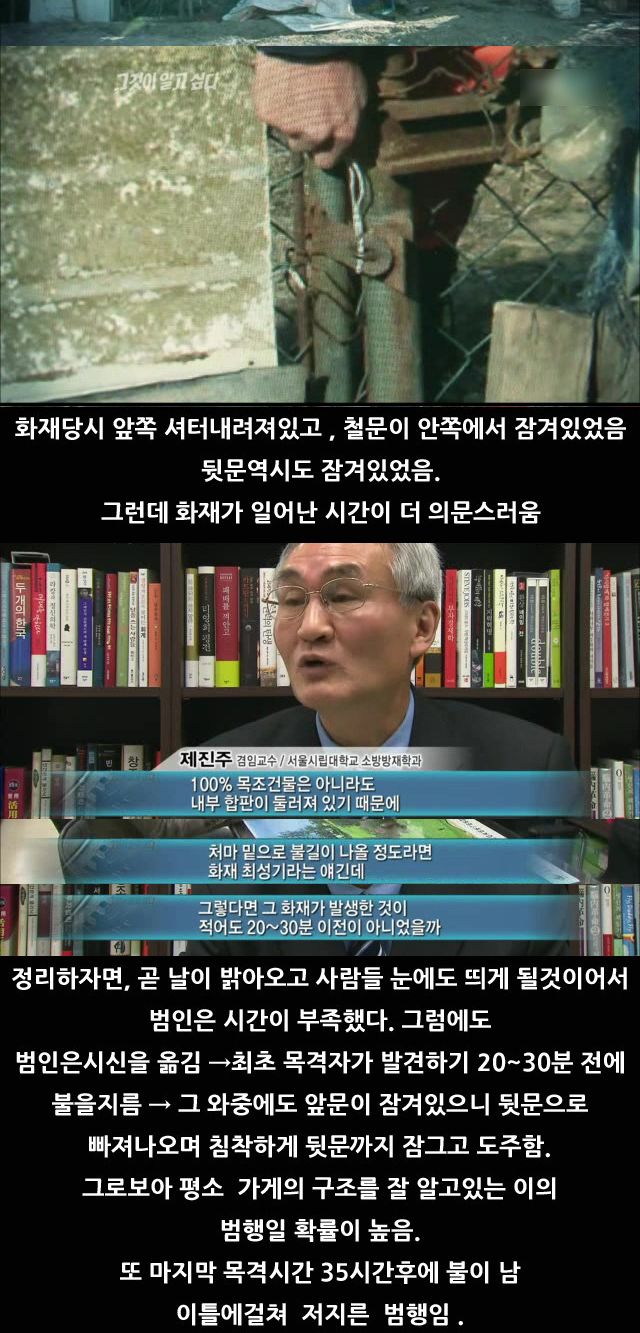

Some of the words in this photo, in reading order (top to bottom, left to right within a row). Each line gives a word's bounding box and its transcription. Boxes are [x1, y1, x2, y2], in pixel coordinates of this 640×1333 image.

[15, 582, 26, 594] 두
[15, 595, 26, 615] 개의
[15, 619, 26, 640] 한국
